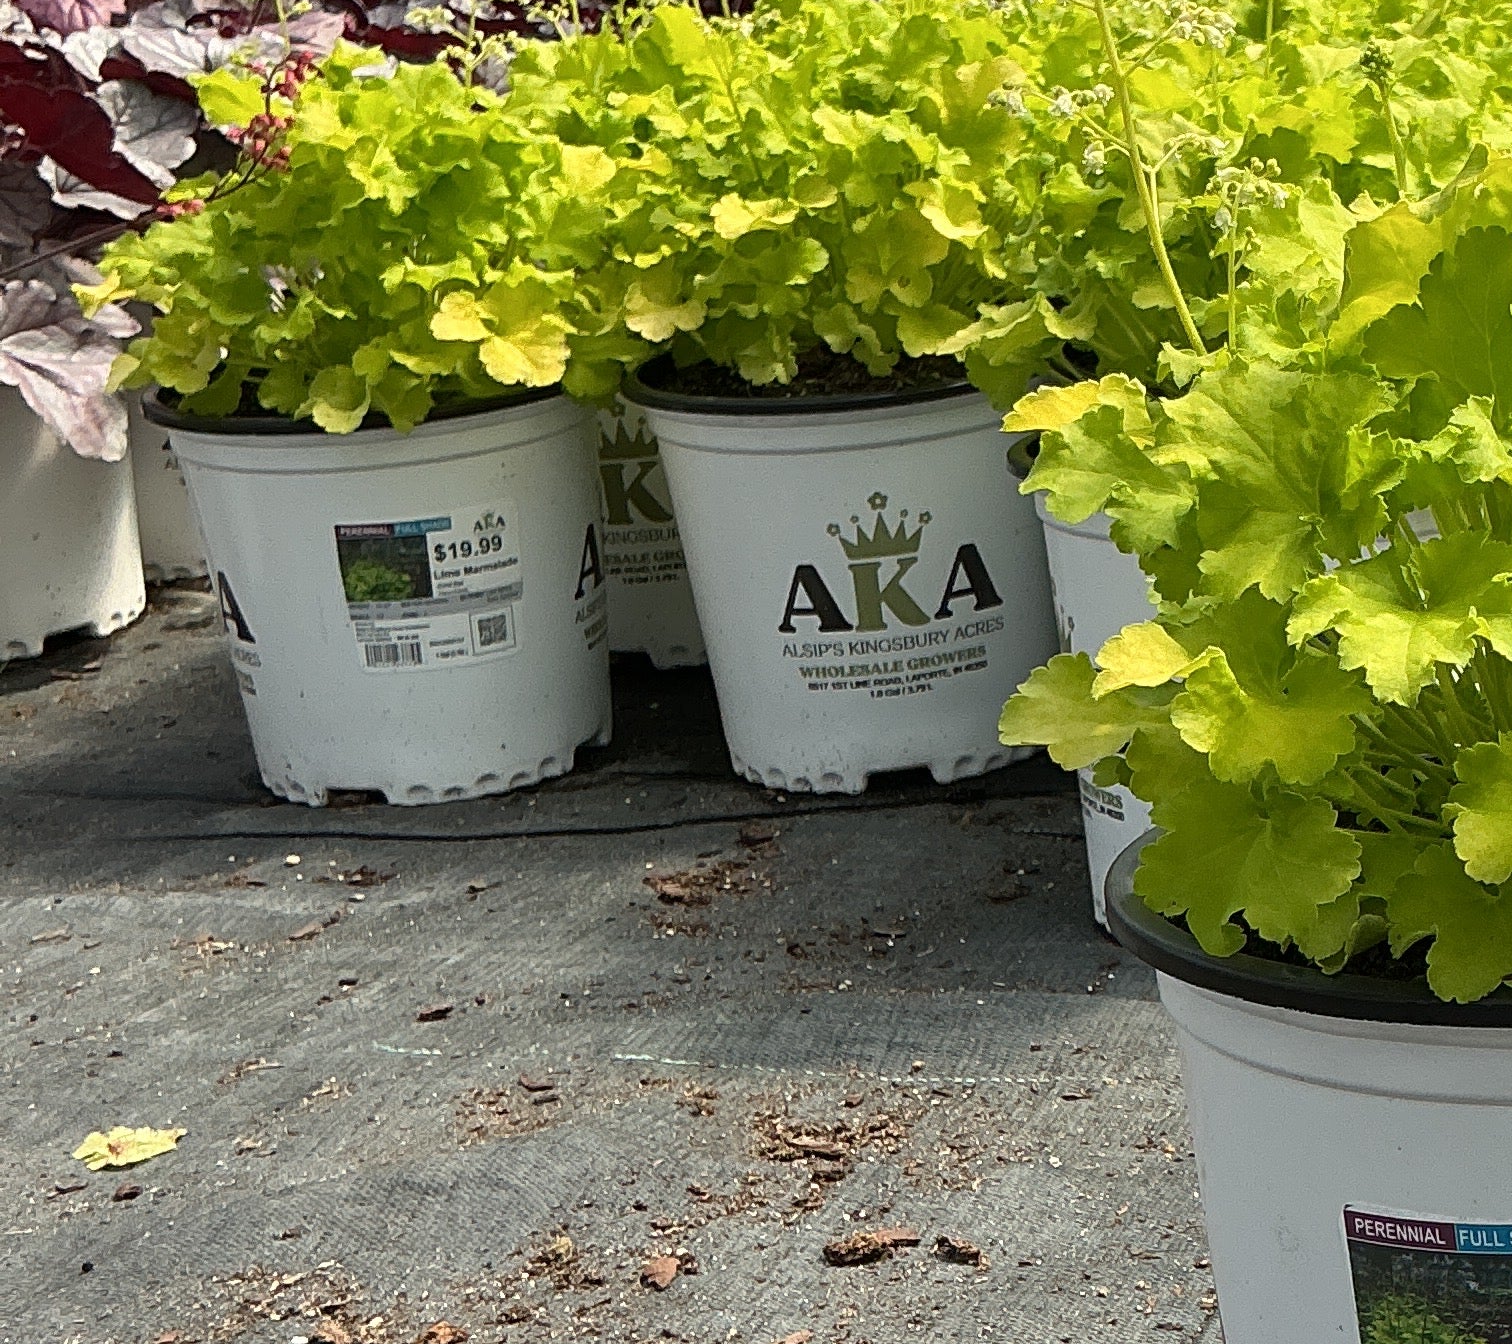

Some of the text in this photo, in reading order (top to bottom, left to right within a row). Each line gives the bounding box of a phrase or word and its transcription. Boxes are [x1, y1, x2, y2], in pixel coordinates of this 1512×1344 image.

[433, 534, 503, 563] $19.99
[778, 543, 1004, 634] AKA
[782, 616, 1005, 659] ALSIP'S KINGSBURY ACRES
[798, 645, 987, 679] WHOLESALE GROWERS
[1354, 1217, 1447, 1245] PERENNIAL
[1459, 1229, 1506, 1247] FULL
